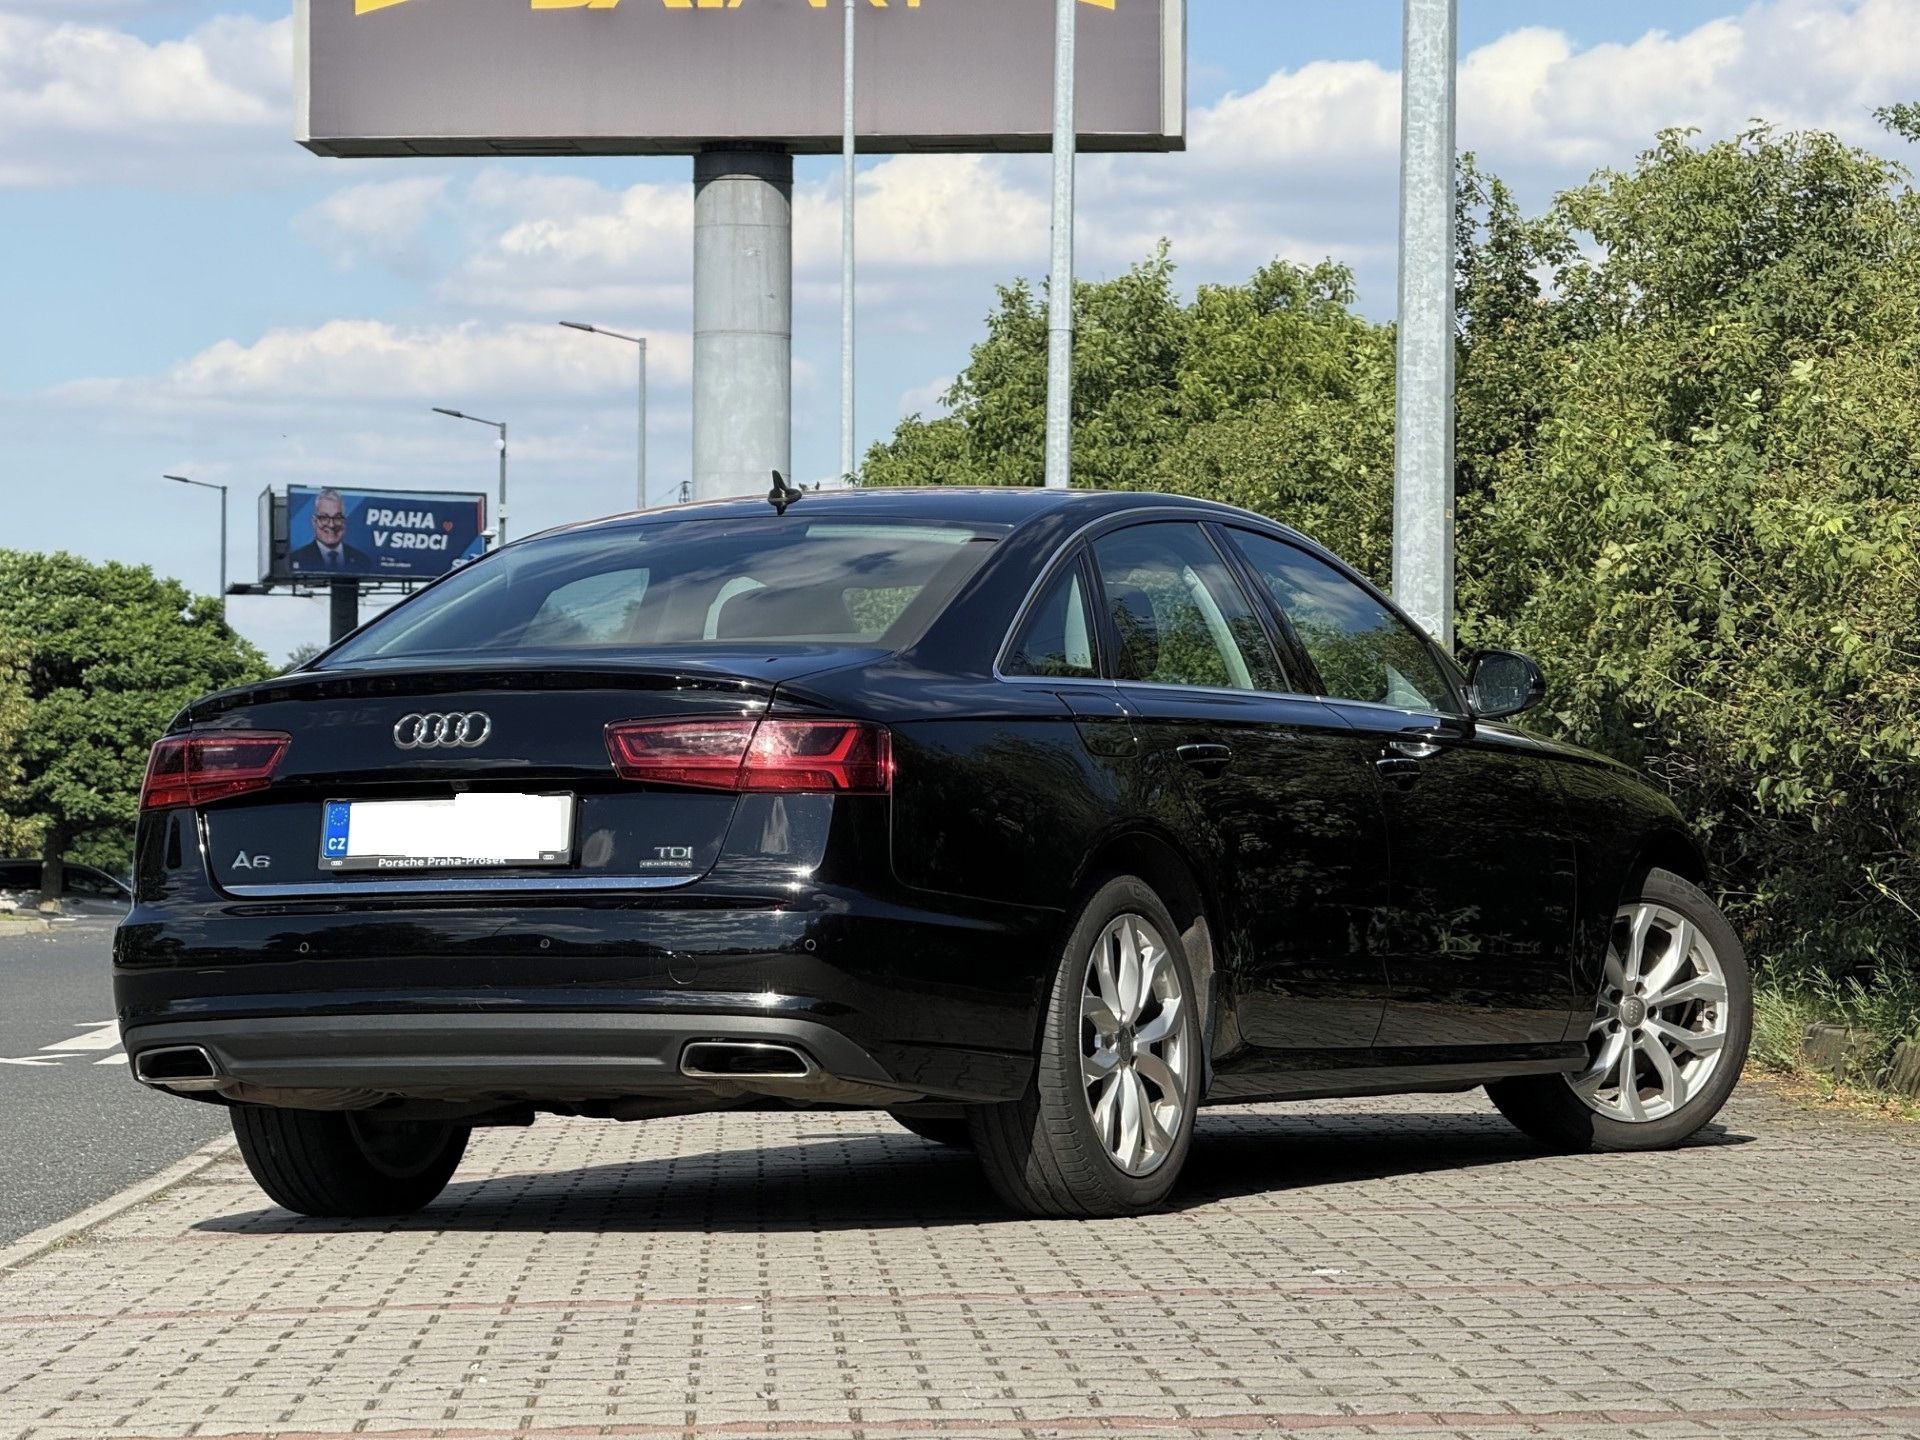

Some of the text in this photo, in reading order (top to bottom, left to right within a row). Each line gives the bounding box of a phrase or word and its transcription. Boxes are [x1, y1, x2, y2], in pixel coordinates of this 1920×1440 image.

[366, 508, 435, 529] PRAHA
[373, 530, 448, 550] V SRDCI
[328, 837, 346, 850] CZ
[231, 850, 271, 870] A6
[654, 846, 692, 858] TDI
[378, 857, 424, 868] Porsche
